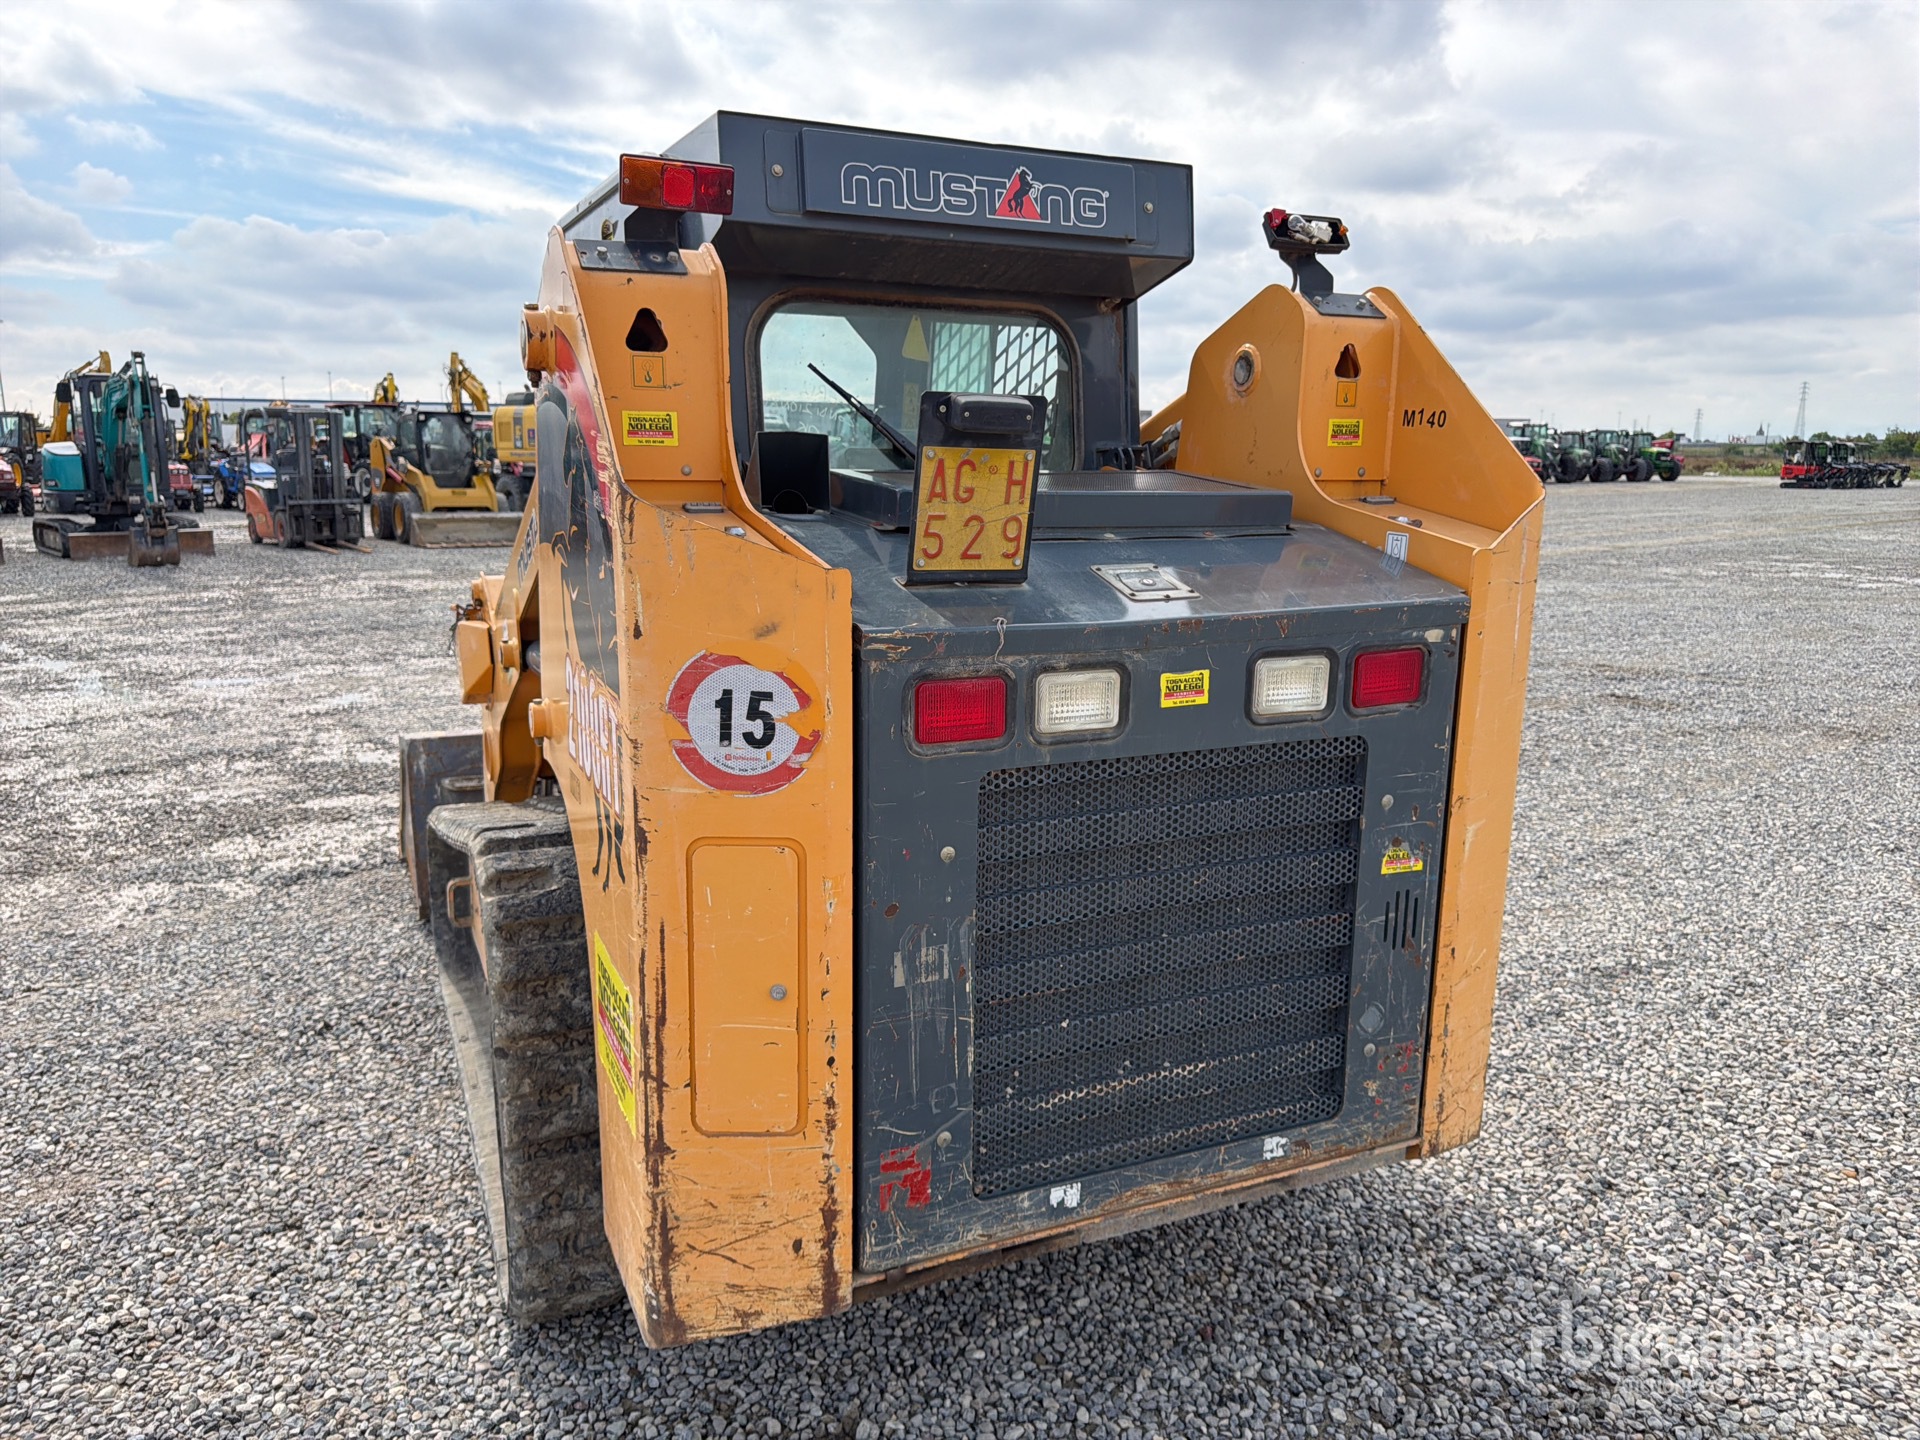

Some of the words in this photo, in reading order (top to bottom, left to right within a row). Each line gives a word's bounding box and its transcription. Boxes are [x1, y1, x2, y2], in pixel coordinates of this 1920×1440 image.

[841, 162, 1107, 228] MUSTANG
[1402, 408, 1447, 428] M140
[1004, 460, 1029, 504] H
[714, 688, 776, 749] 15
